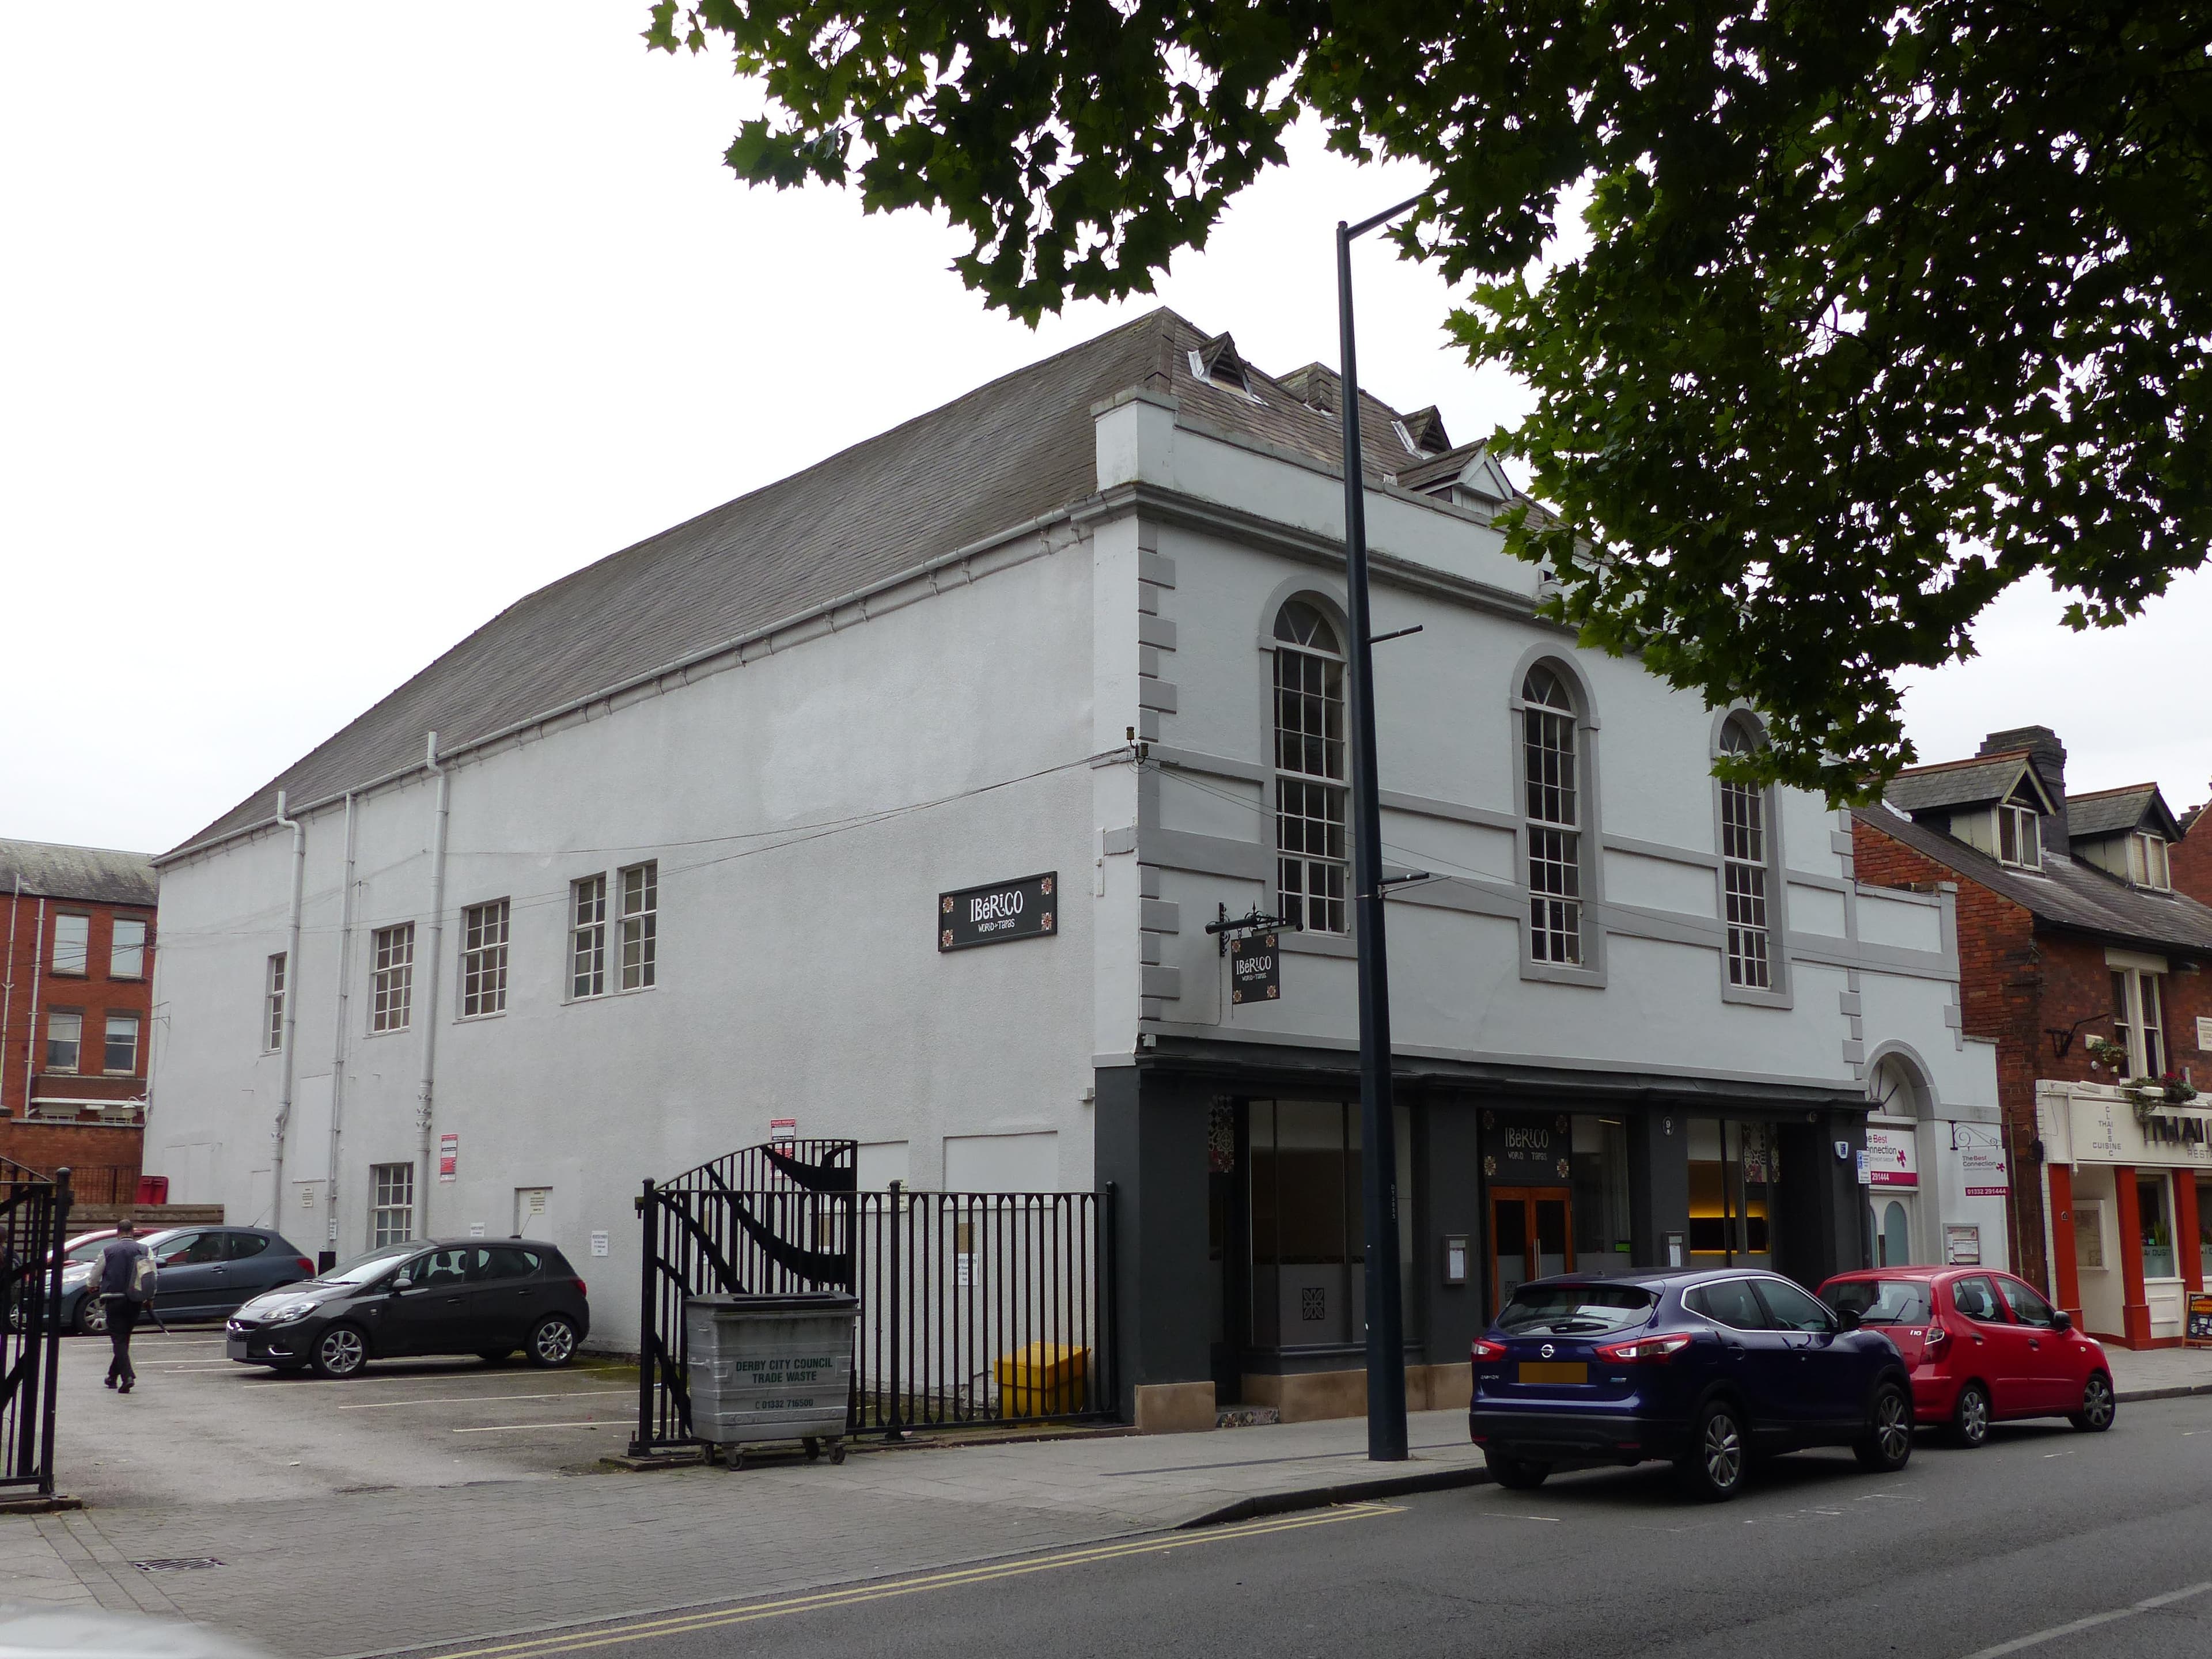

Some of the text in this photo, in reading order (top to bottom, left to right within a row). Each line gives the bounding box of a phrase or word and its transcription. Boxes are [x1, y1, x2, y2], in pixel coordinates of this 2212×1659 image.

[1873, 1134, 1888, 1143] Best
[1872, 1172, 1889, 1181] 291444
[736, 1357, 833, 1372] DERBY CITY COUNCIL
[752, 1370, 816, 1384] TRADE WASTE
[762, 1400, 784, 1409] 01332
[787, 1399, 813, 1407] 716500
